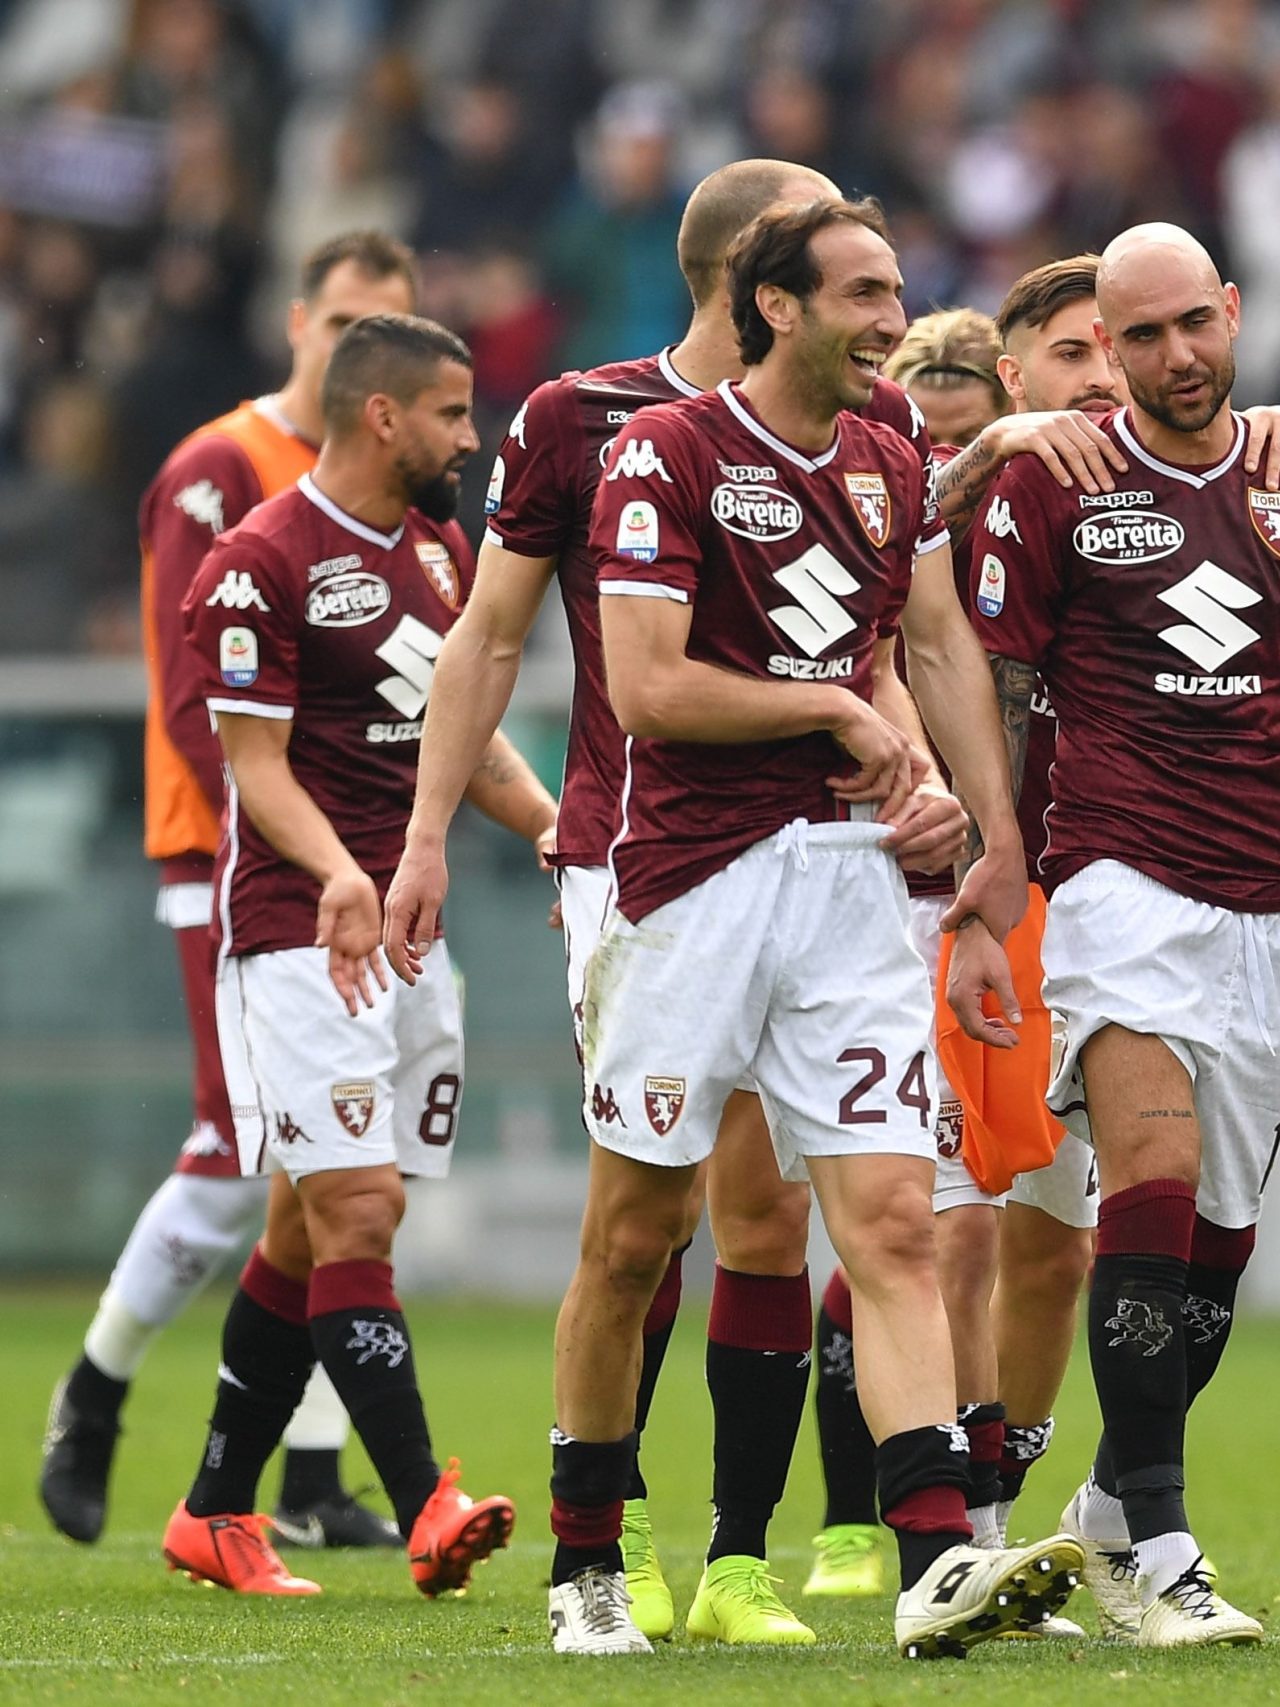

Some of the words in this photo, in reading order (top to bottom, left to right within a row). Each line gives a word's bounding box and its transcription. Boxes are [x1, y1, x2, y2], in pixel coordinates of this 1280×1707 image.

[848, 479, 882, 491] TORINO
[717, 489, 799, 529] Beretta
[1080, 521, 1181, 553] Beretta
[1118, 548, 1145, 558] 1812
[767, 654, 854, 680] SUZUKI
[1154, 673, 1262, 696] SUZUKI
[836, 1047, 931, 1129] 24
[418, 1073, 459, 1147] 8
[937, 1104, 963, 1115] RINO
